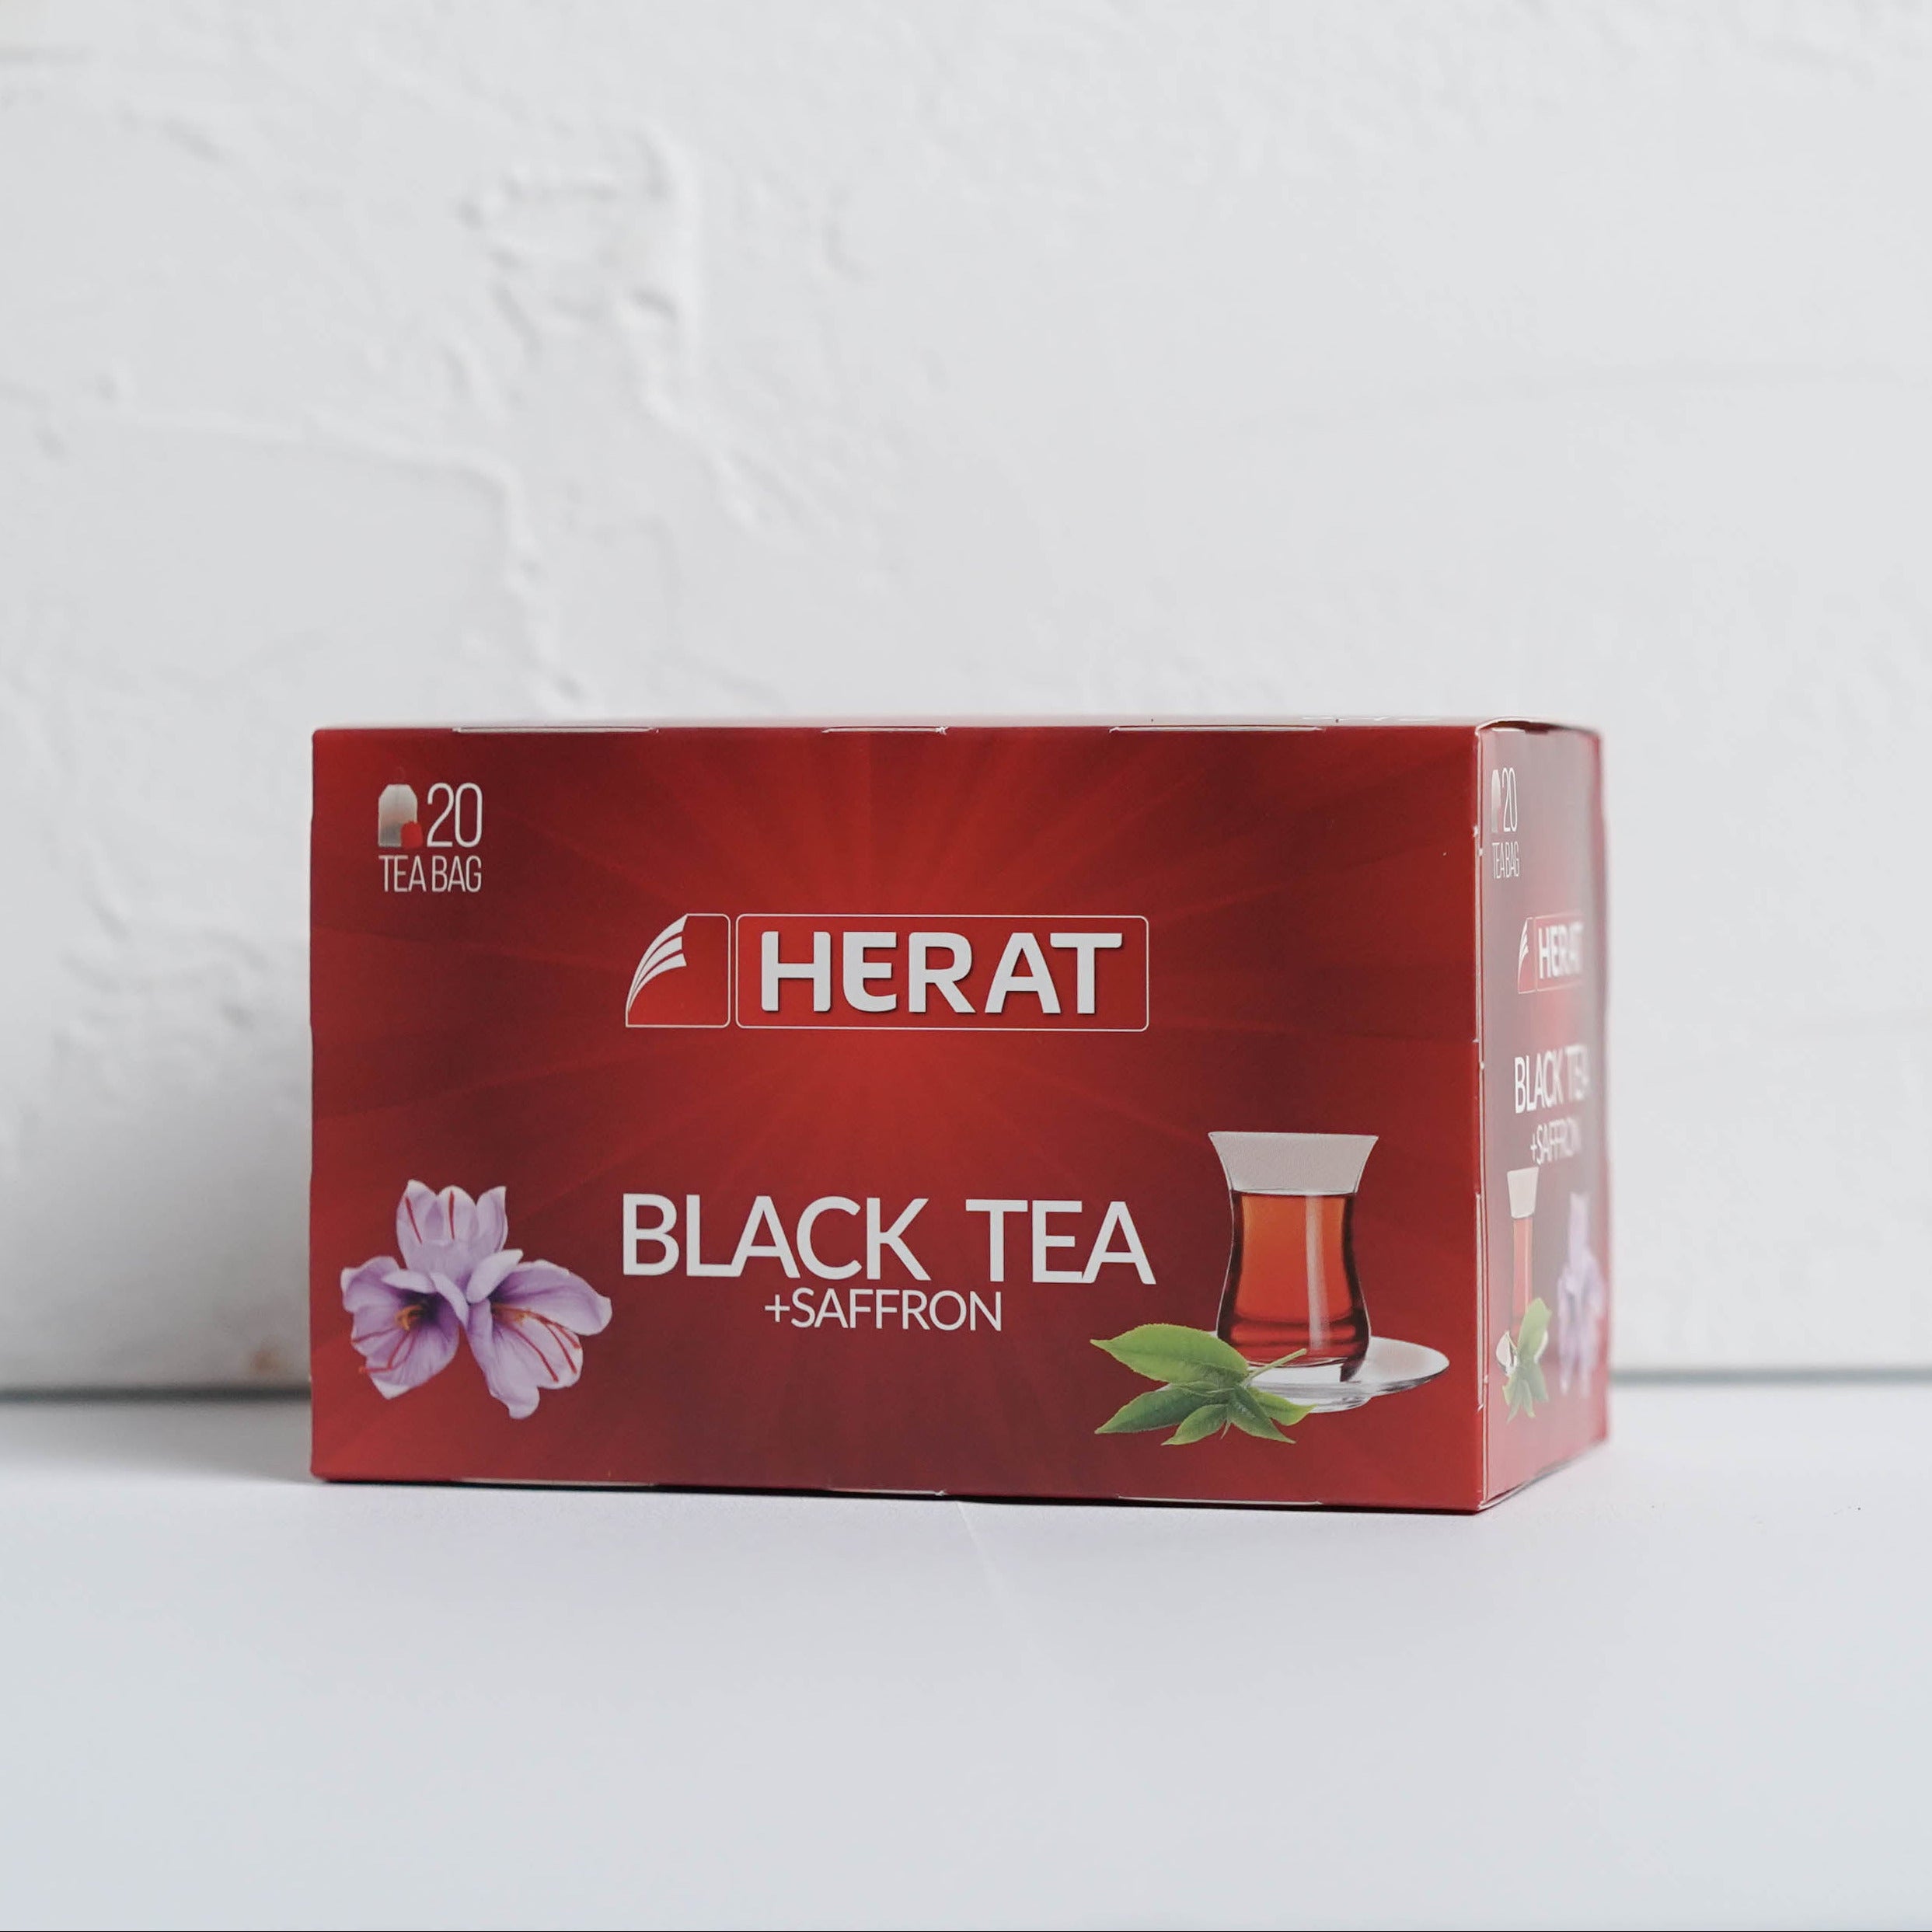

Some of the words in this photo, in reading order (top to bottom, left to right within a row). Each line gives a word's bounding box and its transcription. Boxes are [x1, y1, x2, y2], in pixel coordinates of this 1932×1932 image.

[427, 783, 483, 848] 20
[1502, 767, 1517, 832] 20
[378, 855, 427, 892] TEA
[431, 855, 482, 893] BAG
[1492, 842, 1505, 879] TEA
[1505, 841, 1519, 877] BAG
[761, 931, 1124, 1014] HERAT
[1514, 1048, 1564, 1114] BLACK
[622, 1194, 932, 1281] BLACK
[965, 1199, 1156, 1285] TEA
[765, 1287, 1002, 1332] +SAFFRON
